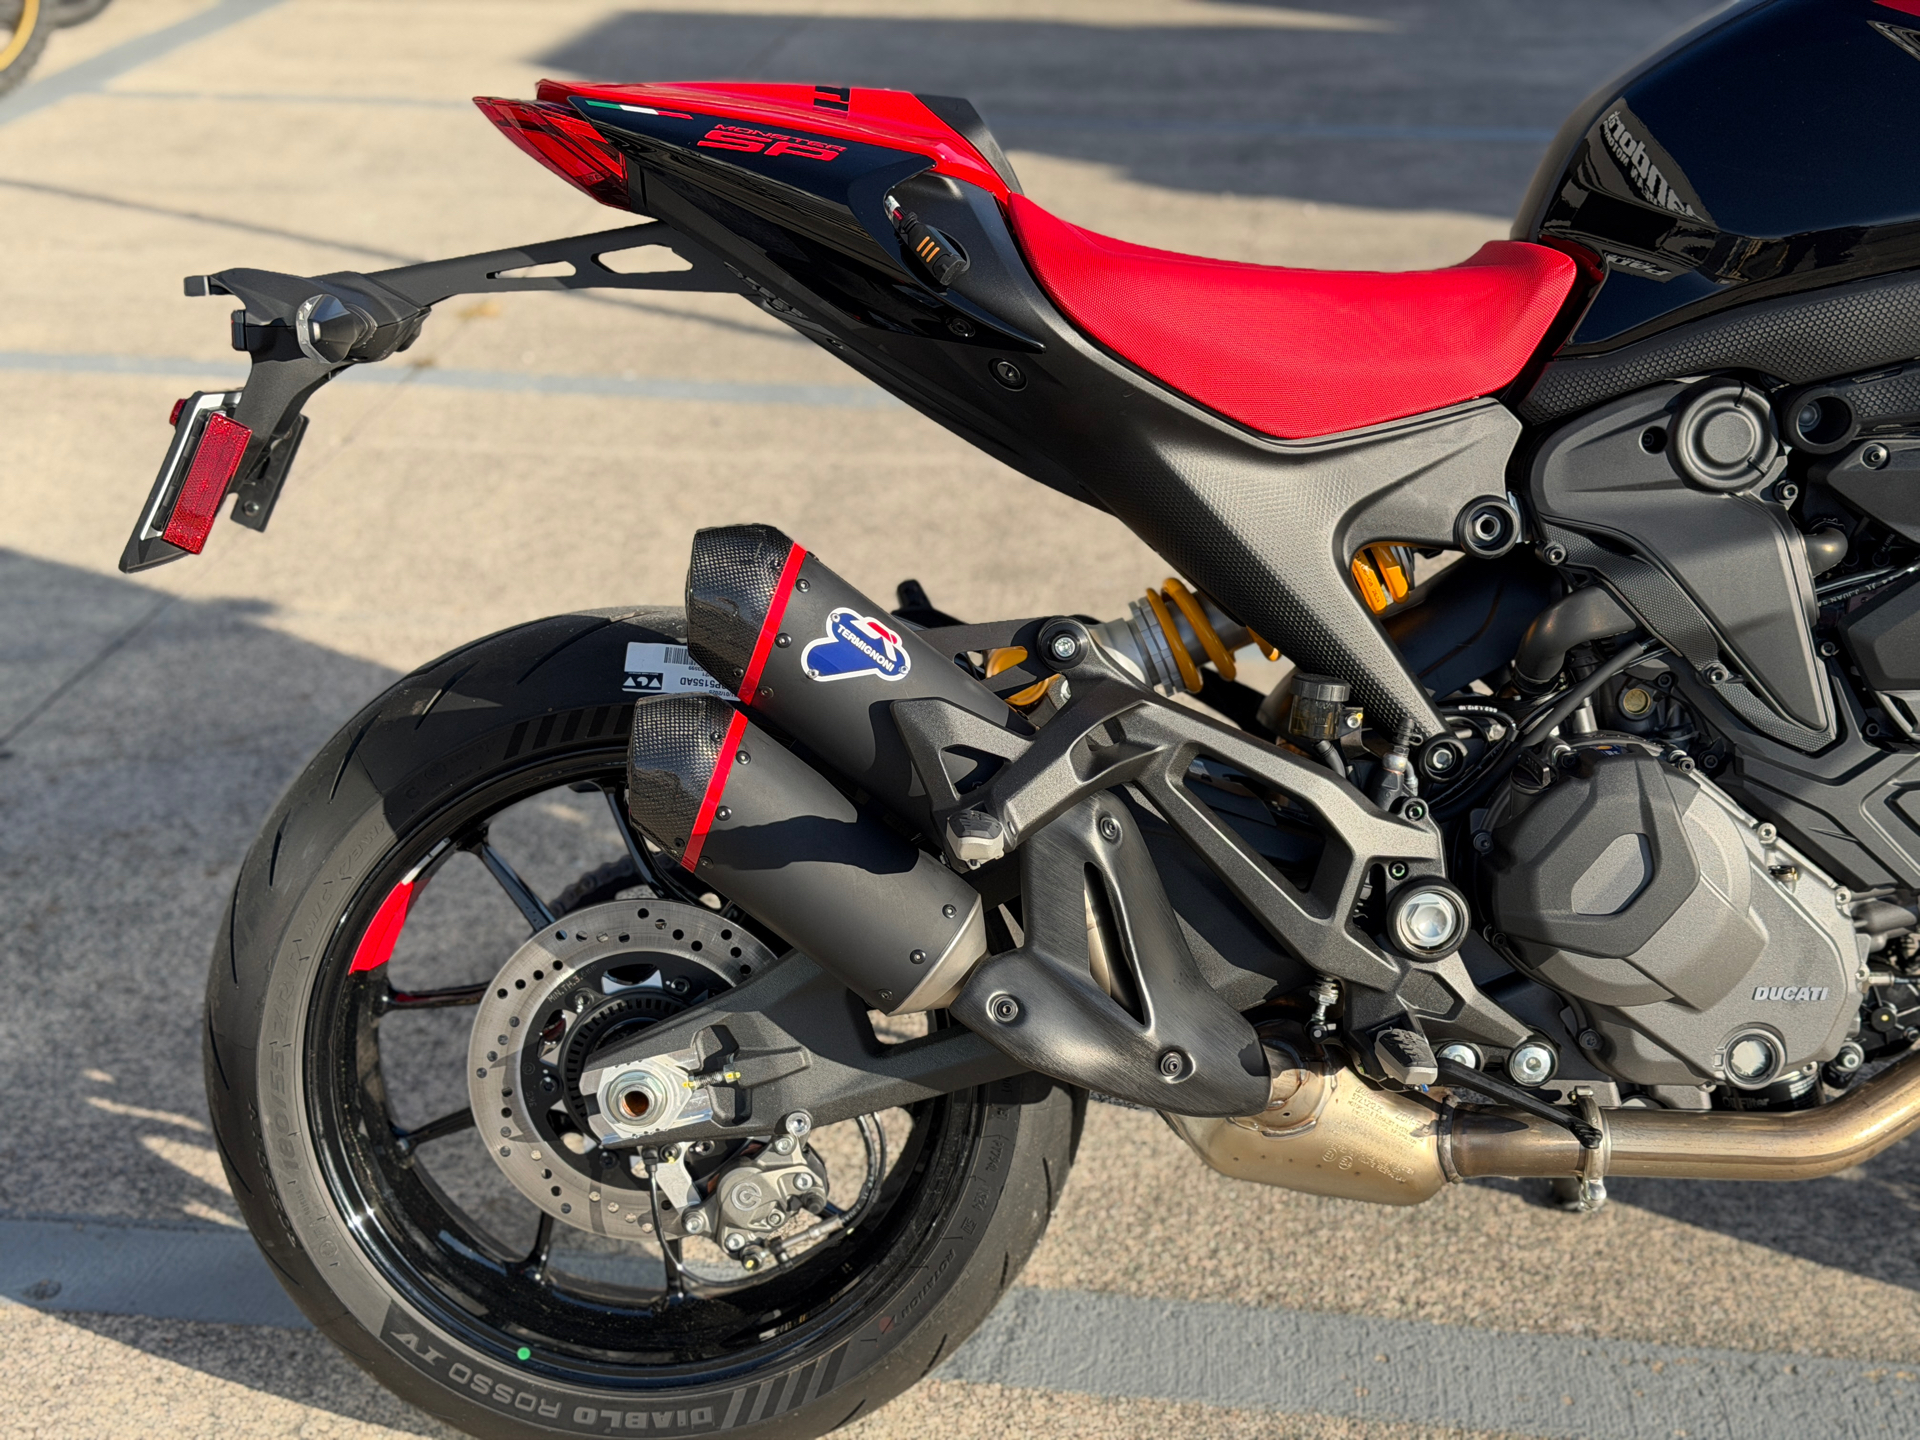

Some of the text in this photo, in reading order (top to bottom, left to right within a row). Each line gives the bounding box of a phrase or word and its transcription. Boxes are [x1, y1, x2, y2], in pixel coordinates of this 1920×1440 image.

[697, 130, 840, 162] SP
[714, 124, 847, 151] MONSTER
[837, 624, 895, 672] TERMIGNONI
[1753, 986, 1828, 1001] DUCATI
[901, 1248, 957, 1317] ROTATION
[389, 1329, 714, 1431] DIABLO ROSSO IV
